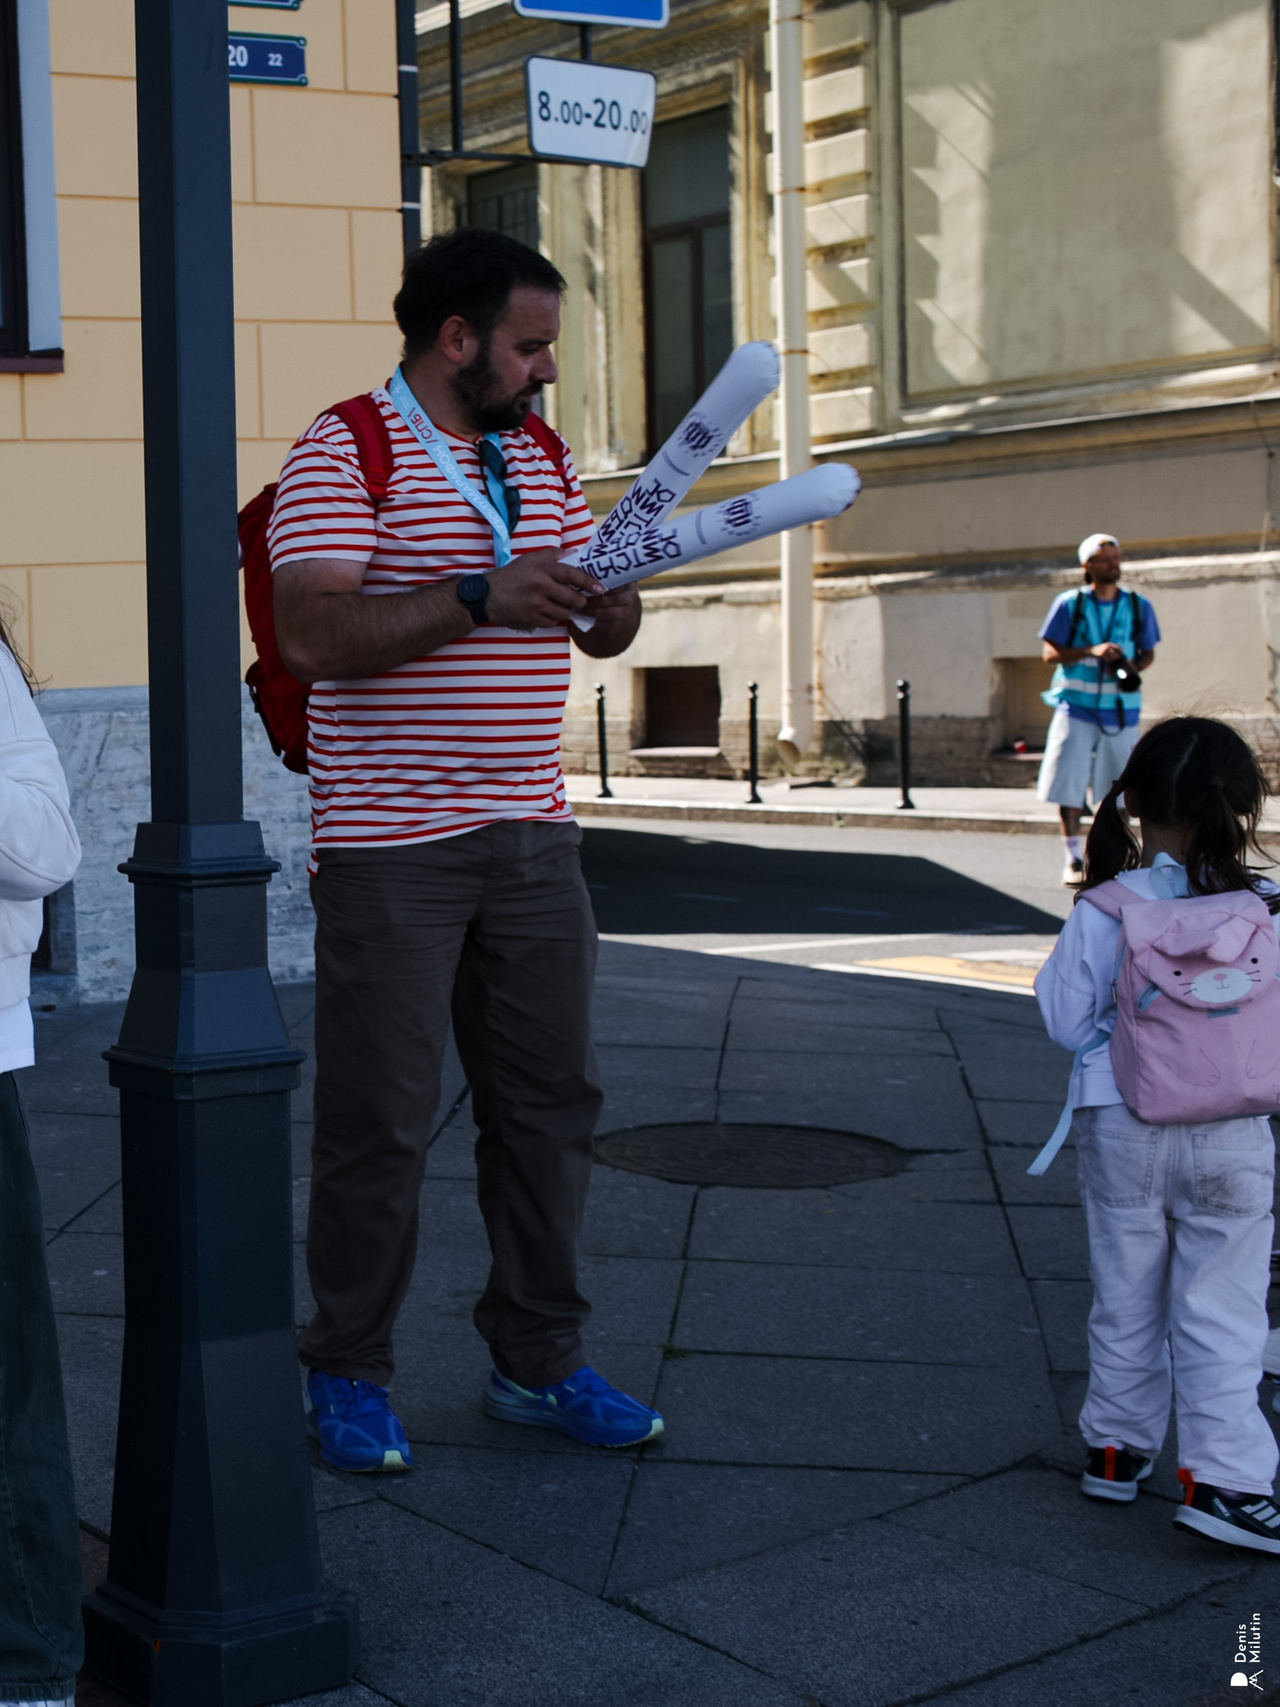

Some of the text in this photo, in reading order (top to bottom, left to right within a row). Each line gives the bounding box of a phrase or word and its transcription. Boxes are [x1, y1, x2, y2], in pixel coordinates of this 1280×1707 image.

[268, 53, 283, 66] 22
[538, 90, 648, 135] 8.00-20.00
[433, 444, 503, 529] ПОЛУМАРАФОН
[581, 528, 681, 580] ДЕТСКИ
